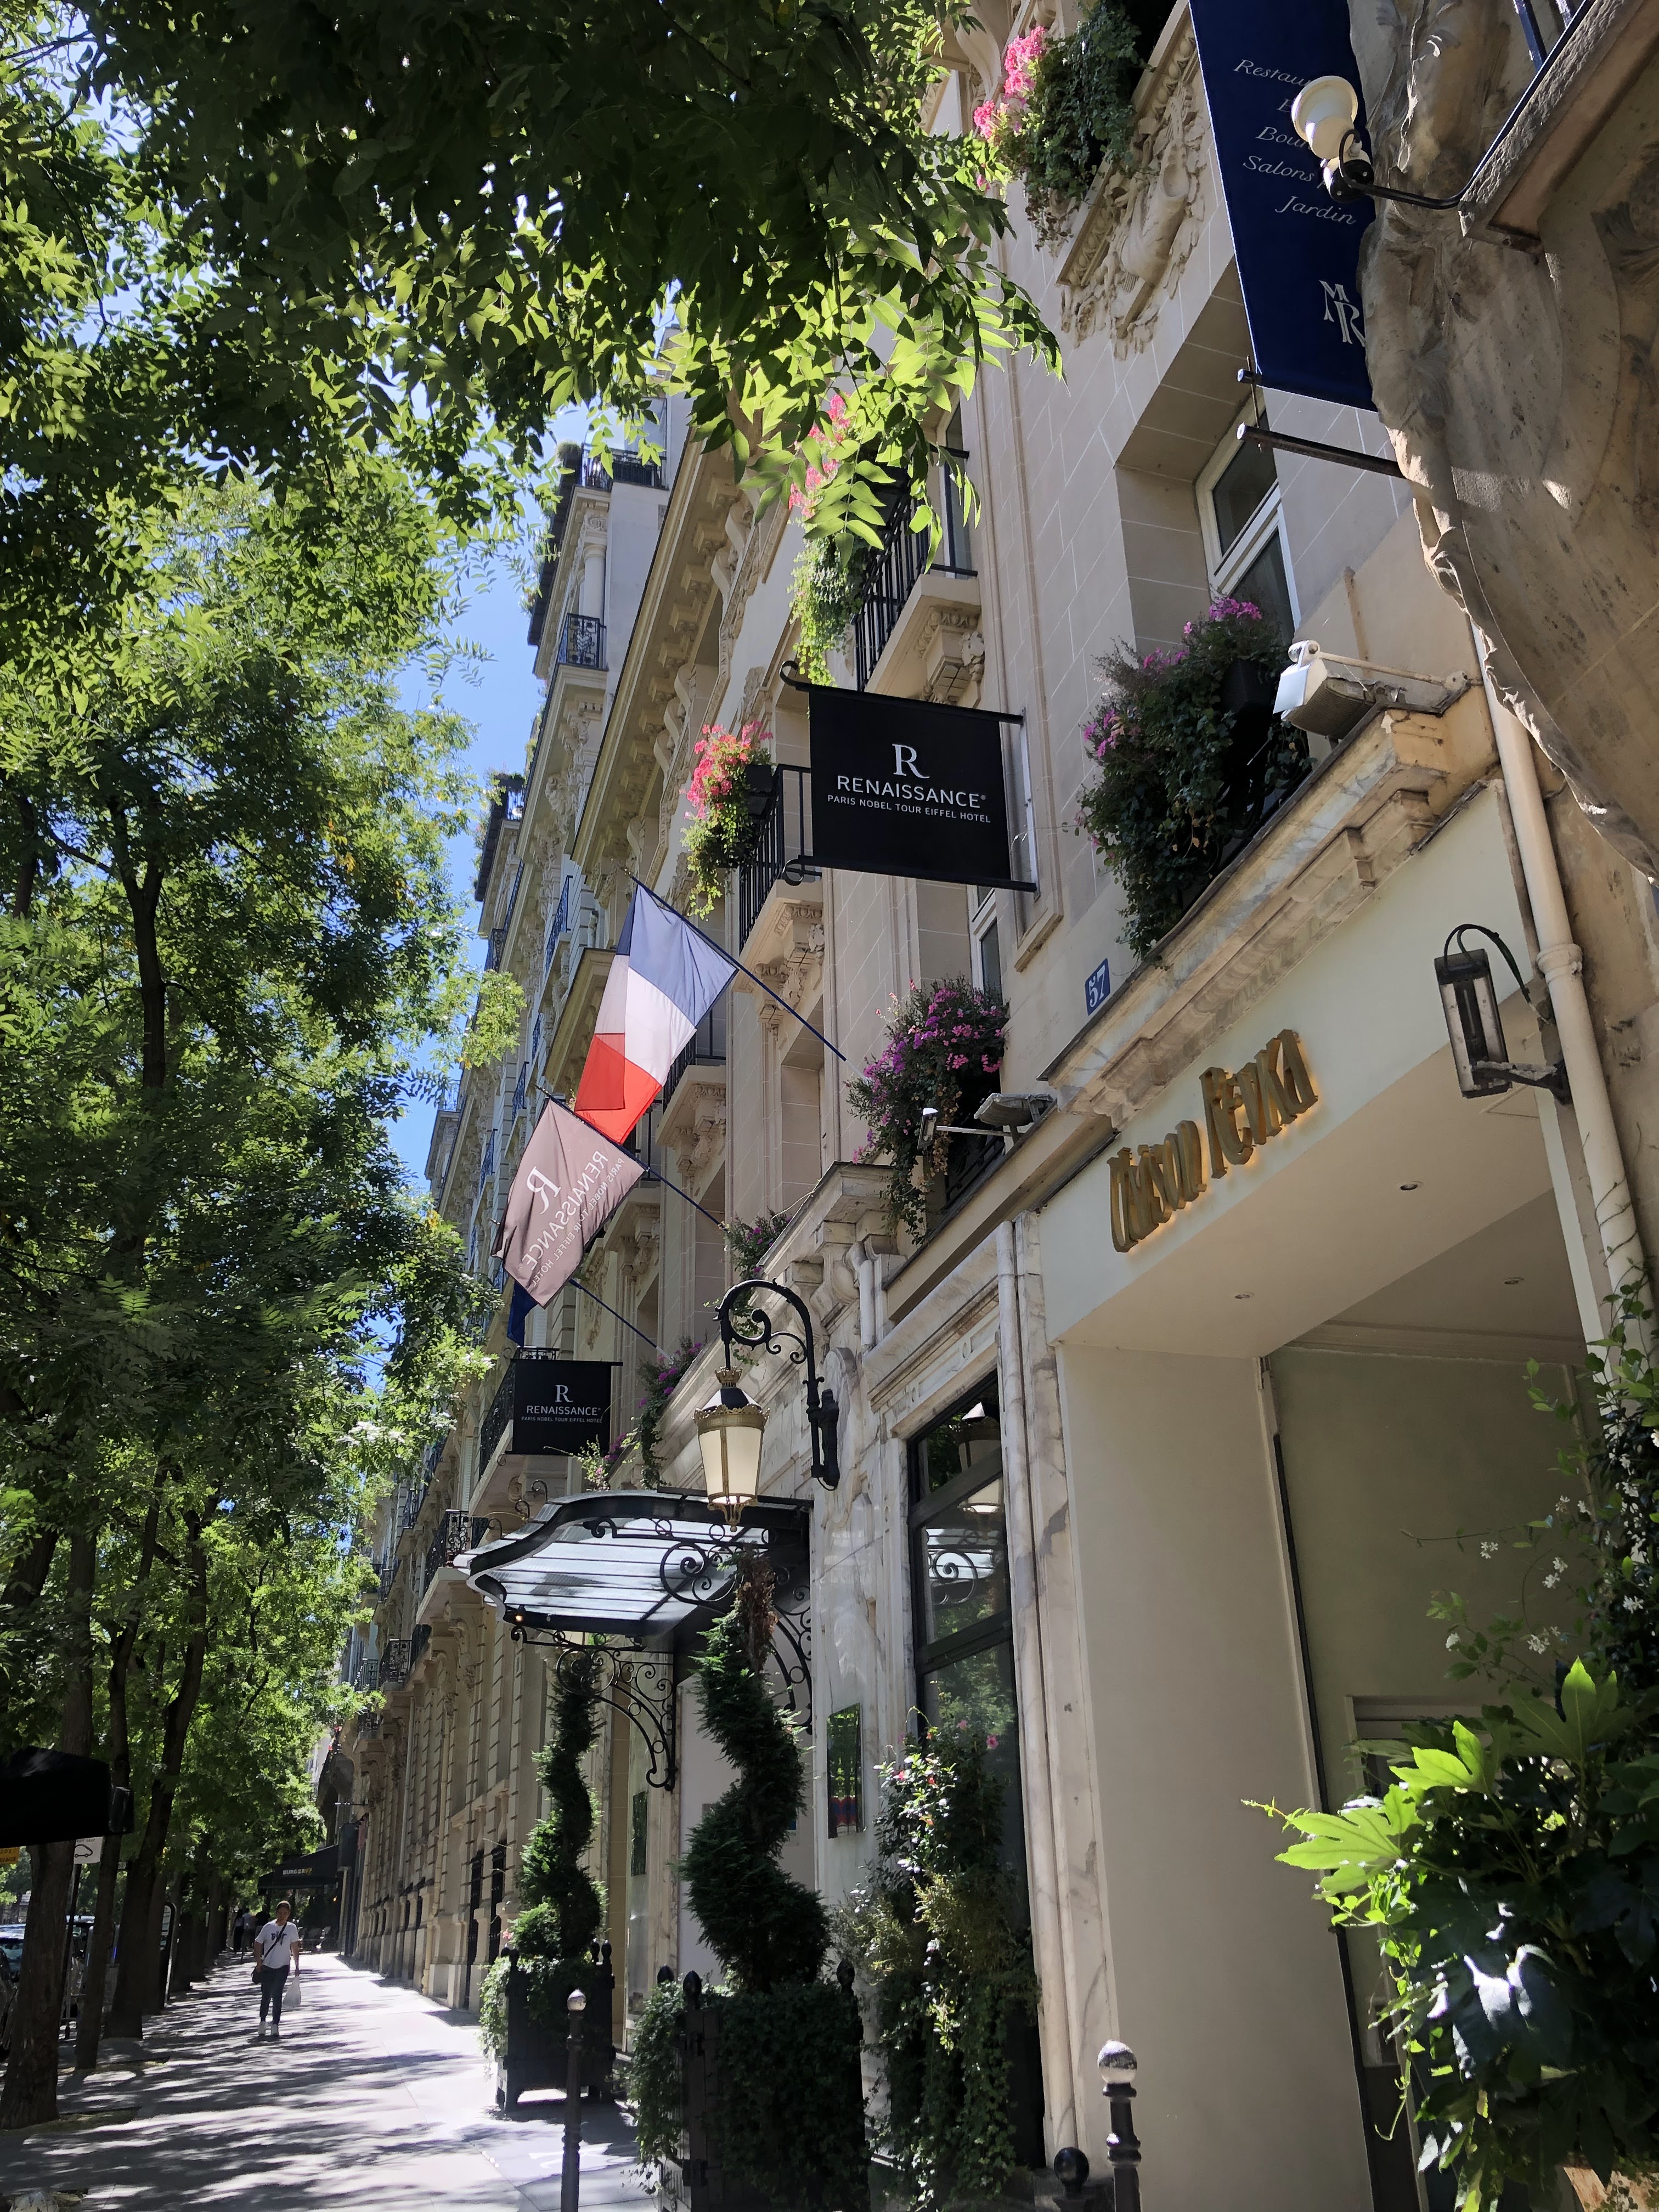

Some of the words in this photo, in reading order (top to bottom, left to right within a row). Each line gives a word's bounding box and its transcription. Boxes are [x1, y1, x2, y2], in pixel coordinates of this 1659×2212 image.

[1243, 155, 1314, 182] Salons
[1275, 195, 1357, 225] Jardin
[891, 743, 930, 779] R
[827, 794, 856, 805] PARIS
[859, 799, 892, 810] NOBEL
[895, 804, 922, 814] TOUR
[925, 808, 957, 819] EIFFEL
[960, 812, 991, 823] HOTEL
[1088, 964, 1105, 1008] 57
[555, 1385, 573, 1403] R
